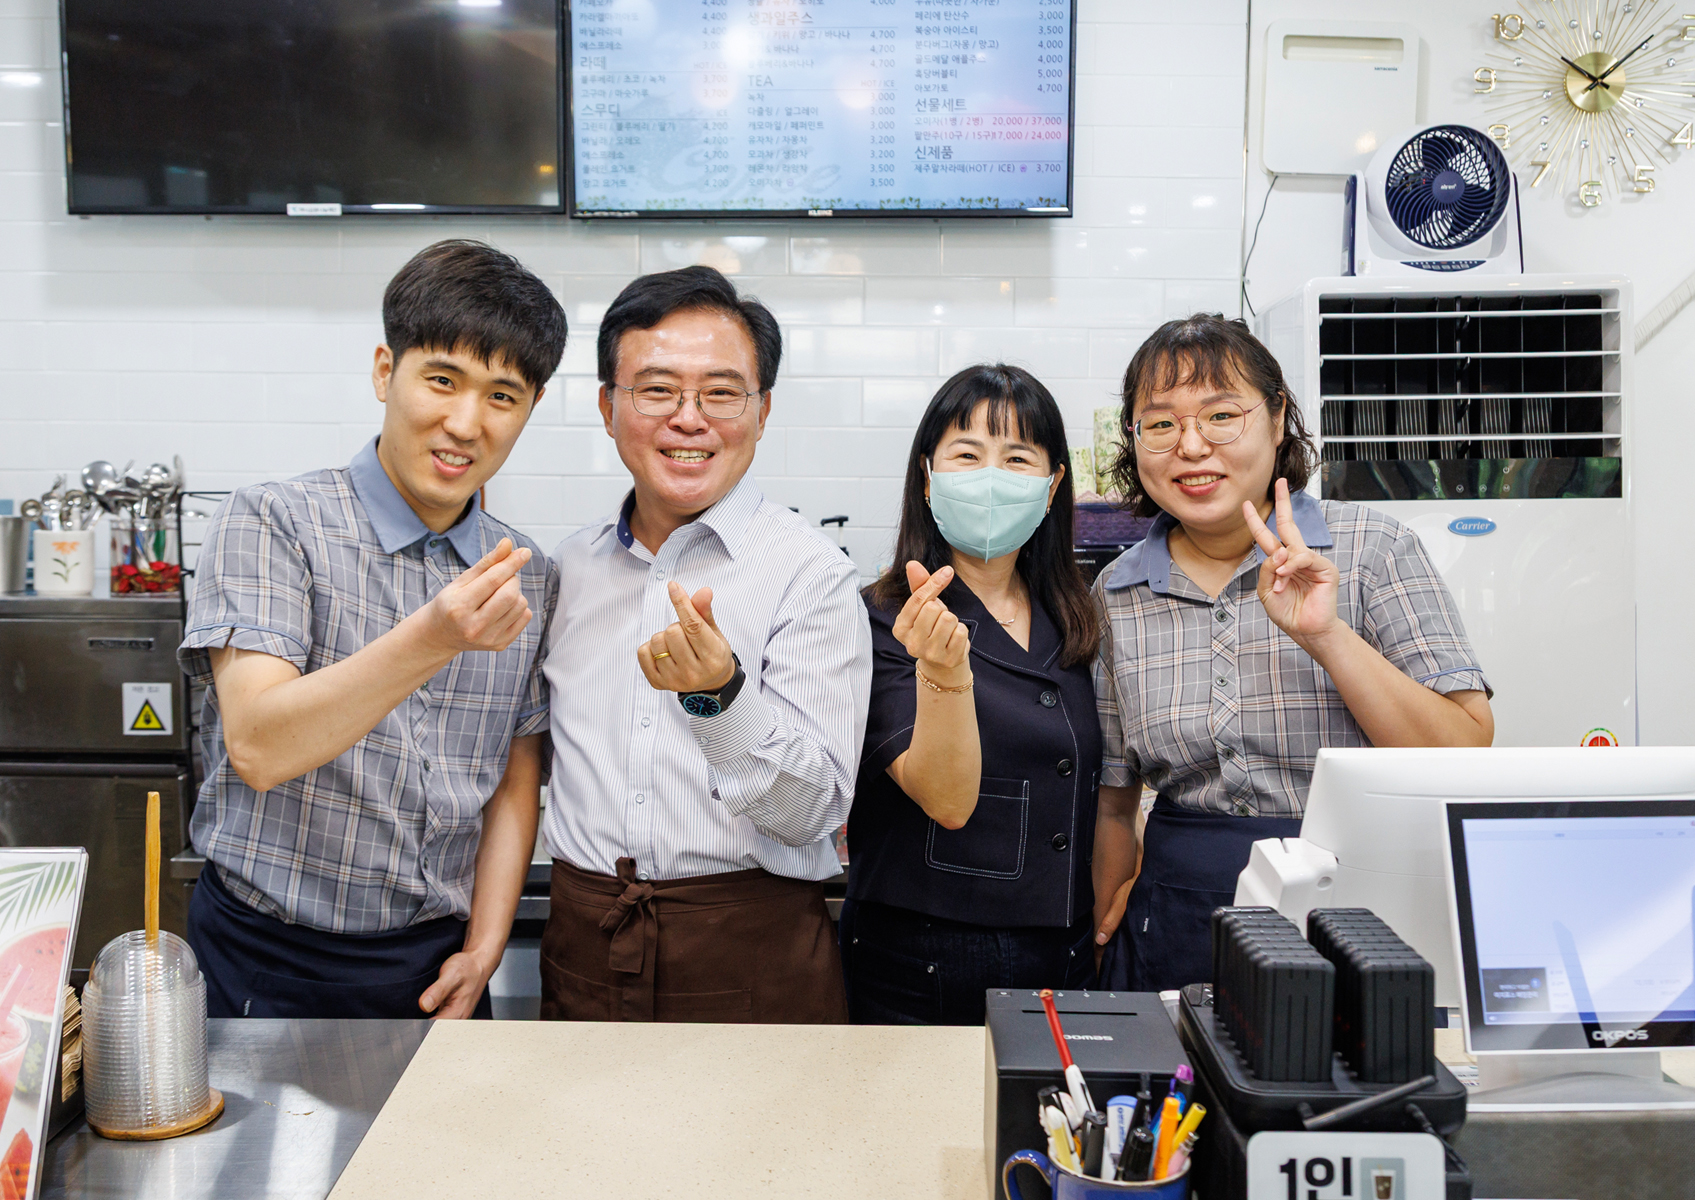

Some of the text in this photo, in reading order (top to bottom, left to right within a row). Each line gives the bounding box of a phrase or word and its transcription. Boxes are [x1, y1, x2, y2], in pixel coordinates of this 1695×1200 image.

[702, 12, 727, 22] 4,400
[747, 11, 814, 26] 생과일주스
[914, 11, 1064, 21] 페리에 탄산수 3,000
[702, 27, 727, 37] 4,400
[914, 25, 1064, 35] 복숭아 아이스티 3,500
[1491, 13, 1524, 41] 10
[799, 30, 816, 40] 망고
[825, 30, 850, 40] 바나나
[870, 30, 896, 40] 4,700
[579, 41, 622, 50] 에스프레소
[870, 44, 895, 54] 4,700
[1038, 40, 1063, 50] 4,000
[580, 56, 607, 71] 라떼
[870, 59, 895, 69] 4,700
[1037, 54, 1063, 64] 4,000
[693, 62, 710, 70] HOT
[623, 74, 640, 84] 초코
[649, 74, 666, 84] 녹차
[703, 74, 727, 84] 3,700
[1037, 69, 1063, 79] 5,000
[747, 75, 774, 87] TEA
[1473, 67, 1497, 94] 9
[1037, 83, 1062, 93] 4,700
[581, 89, 606, 99] 고구마
[703, 89, 727, 99] 3,700
[747, 93, 895, 102] 녹차 3,000
[914, 98, 968, 112] 선물세트
[580, 103, 620, 118] 스무디
[785, 106, 819, 116] 얼그레이
[870, 106, 895, 116] 3,000
[790, 121, 825, 131] 페퍼민트
[870, 121, 895, 131] 3,000
[992, 116, 1023, 127] 20,000
[1031, 116, 1062, 127] 37,000
[581, 122, 607, 132] 그린티
[657, 122, 676, 132] 딸기
[703, 122, 728, 132] 4,200
[748, 135, 773, 145] 유자차
[782, 135, 808, 145] 자몽차
[870, 135, 895, 145] 3,200
[1031, 130, 1062, 141] 24,000
[1671, 121, 1695, 150] 4
[616, 136, 641, 146] 오레오
[703, 136, 728, 146] 4,700
[582, 151, 728, 160] 에스프레소 4,700
[748, 150, 774, 159] 모과차
[782, 150, 808, 159] 생강차
[870, 150, 895, 159] 3,200
[914, 145, 954, 160] 신제품
[610, 164, 636, 174] 요거트
[704, 164, 729, 174] 3,700
[748, 164, 774, 173] 레몬차
[870, 164, 895, 173] 3,500
[1036, 163, 1061, 173] 3,700
[1529, 160, 1551, 188] 7
[1633, 165, 1655, 193] 5
[582, 178, 729, 188] 망고 요거트 4,200
[870, 178, 895, 187] 3,500
[1579, 180, 1602, 208] 6
[1455, 521, 1491, 530] Carrier
[1591, 1029, 1649, 1042] OKPOS
